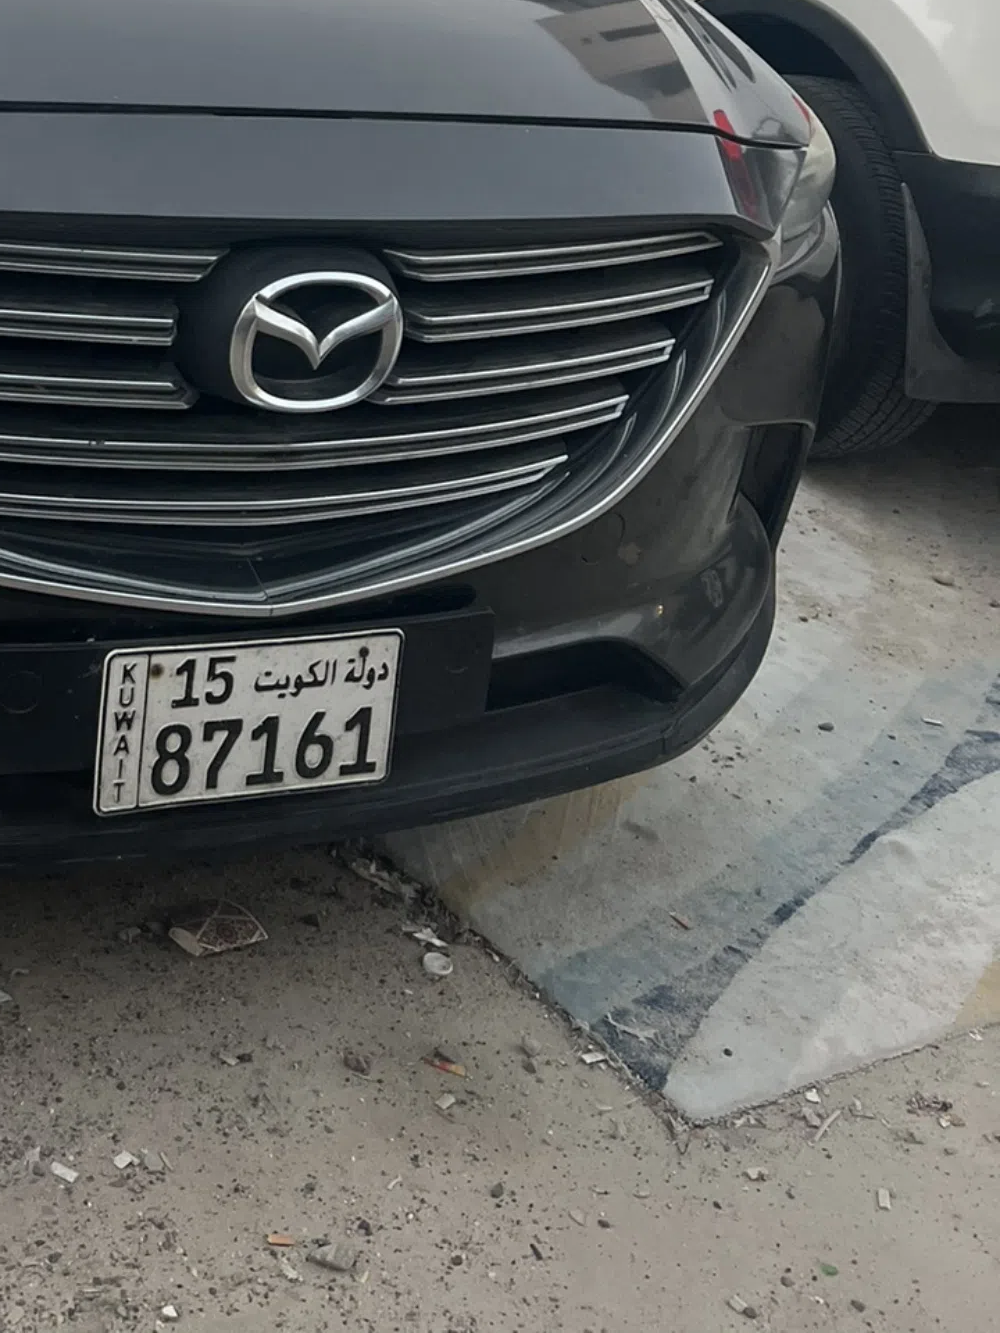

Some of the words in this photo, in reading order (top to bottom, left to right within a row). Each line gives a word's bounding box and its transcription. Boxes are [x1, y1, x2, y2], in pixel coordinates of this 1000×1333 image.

[171, 655, 237, 709] 15
[254, 659, 337, 698] الكويت
[344, 655, 389, 690] دولة
[113, 663, 137, 803] KUWAIT
[151, 706, 377, 796] 87161
